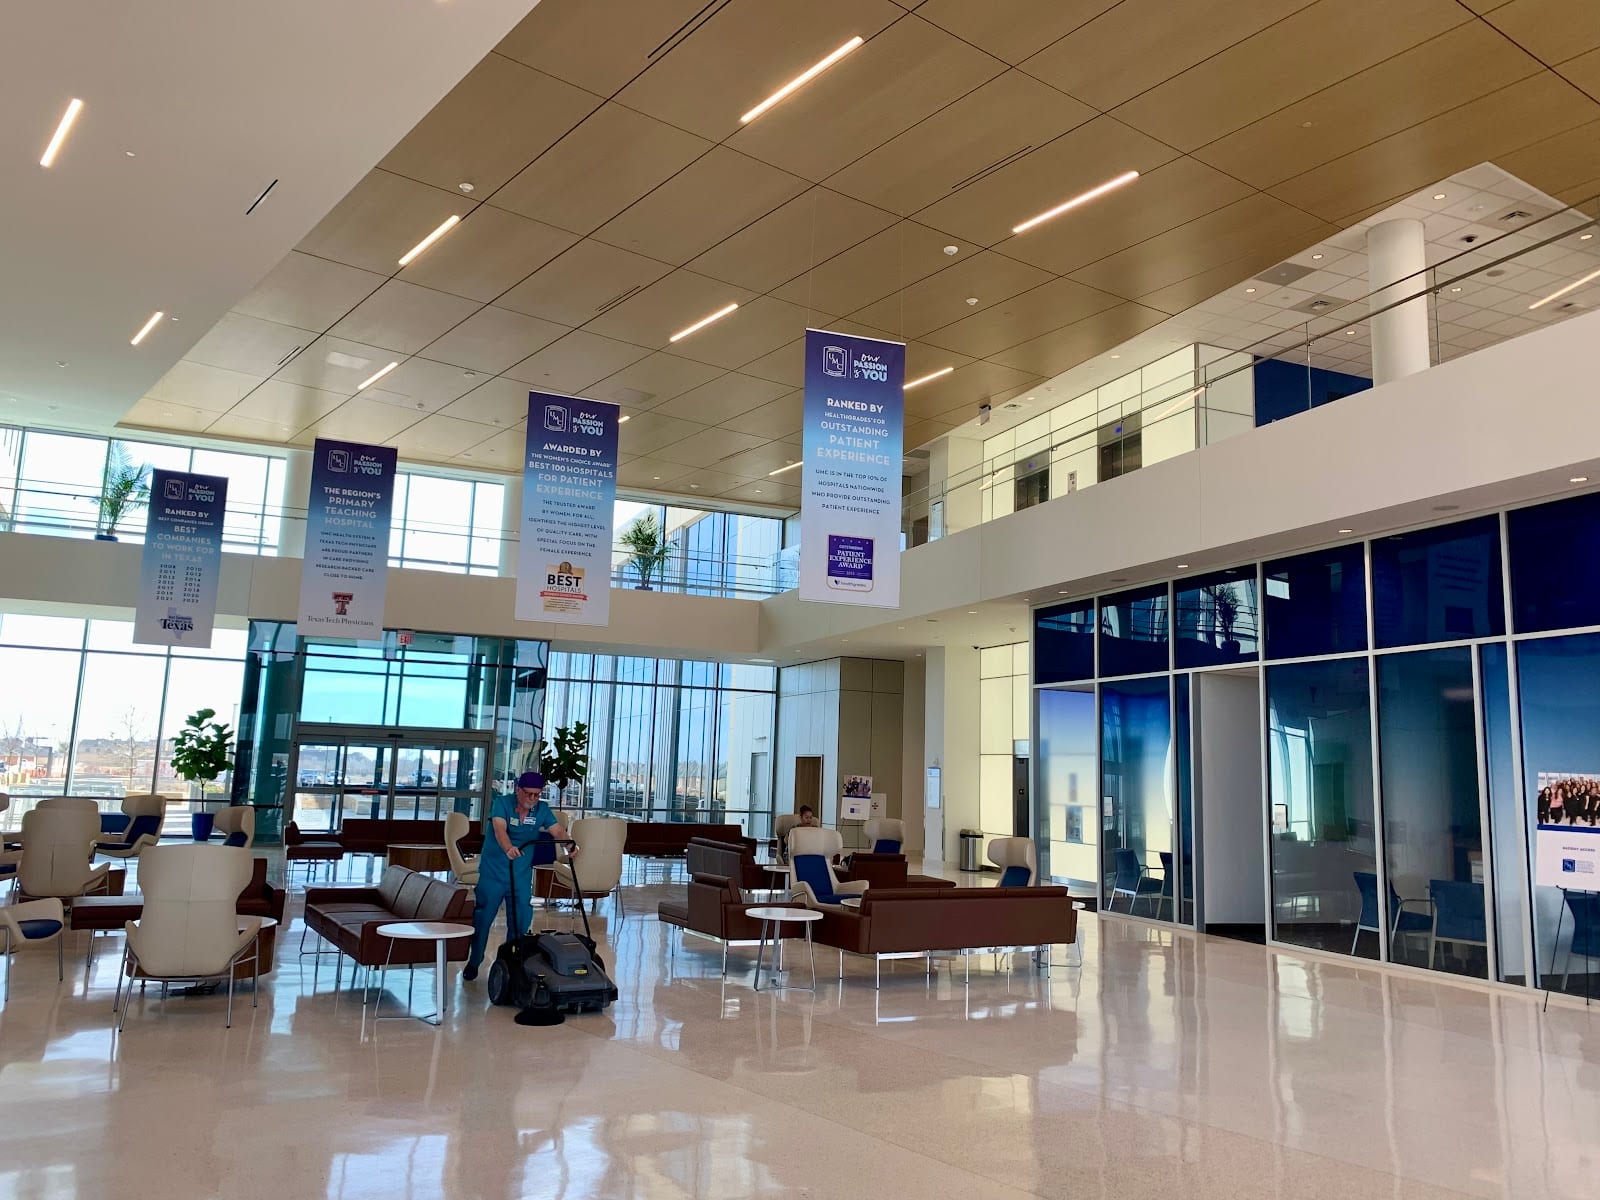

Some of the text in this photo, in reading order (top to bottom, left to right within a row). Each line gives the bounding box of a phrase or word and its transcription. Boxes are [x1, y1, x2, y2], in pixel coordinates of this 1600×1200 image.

[854, 360, 887, 371] PASSION
[862, 369, 887, 381] YOU
[827, 398, 883, 413] RANKED BY
[573, 417, 603, 427] PASSION
[580, 426, 603, 436] YOU
[821, 421, 888, 437] OUTSTANDING
[830, 435, 880, 449] PATIENT
[543, 443, 602, 457] AWARDED BY
[817, 447, 890, 465] EXPERIENCE
[359, 467, 381, 475] YOU
[529, 461, 551, 469] BEST
[567, 466, 613, 478] HOSPITALS
[539, 474, 603, 487] FOR PATIENT
[819, 480, 884, 493] HOSPITALS NATIONWIDE
[342, 489, 381, 499] REGION'S
[536, 485, 604, 500] EXPERIENCE
[329, 497, 374, 508] PRIMARY
[165, 508, 197, 517] RANKED
[325, 506, 376, 518] TEACHING
[847, 506, 880, 514] EXPERIENCE
[325, 517, 374, 528] HOSPITAL
[157, 533, 211, 545] COMPANIES
[167, 544, 192, 552] WORK
[175, 554, 202, 562] TEXAS
[830, 555, 872, 564] EXPERIENCE
[548, 574, 582, 587] BEST
[160, 619, 193, 631] Texas
[307, 615, 324, 623] Texas
